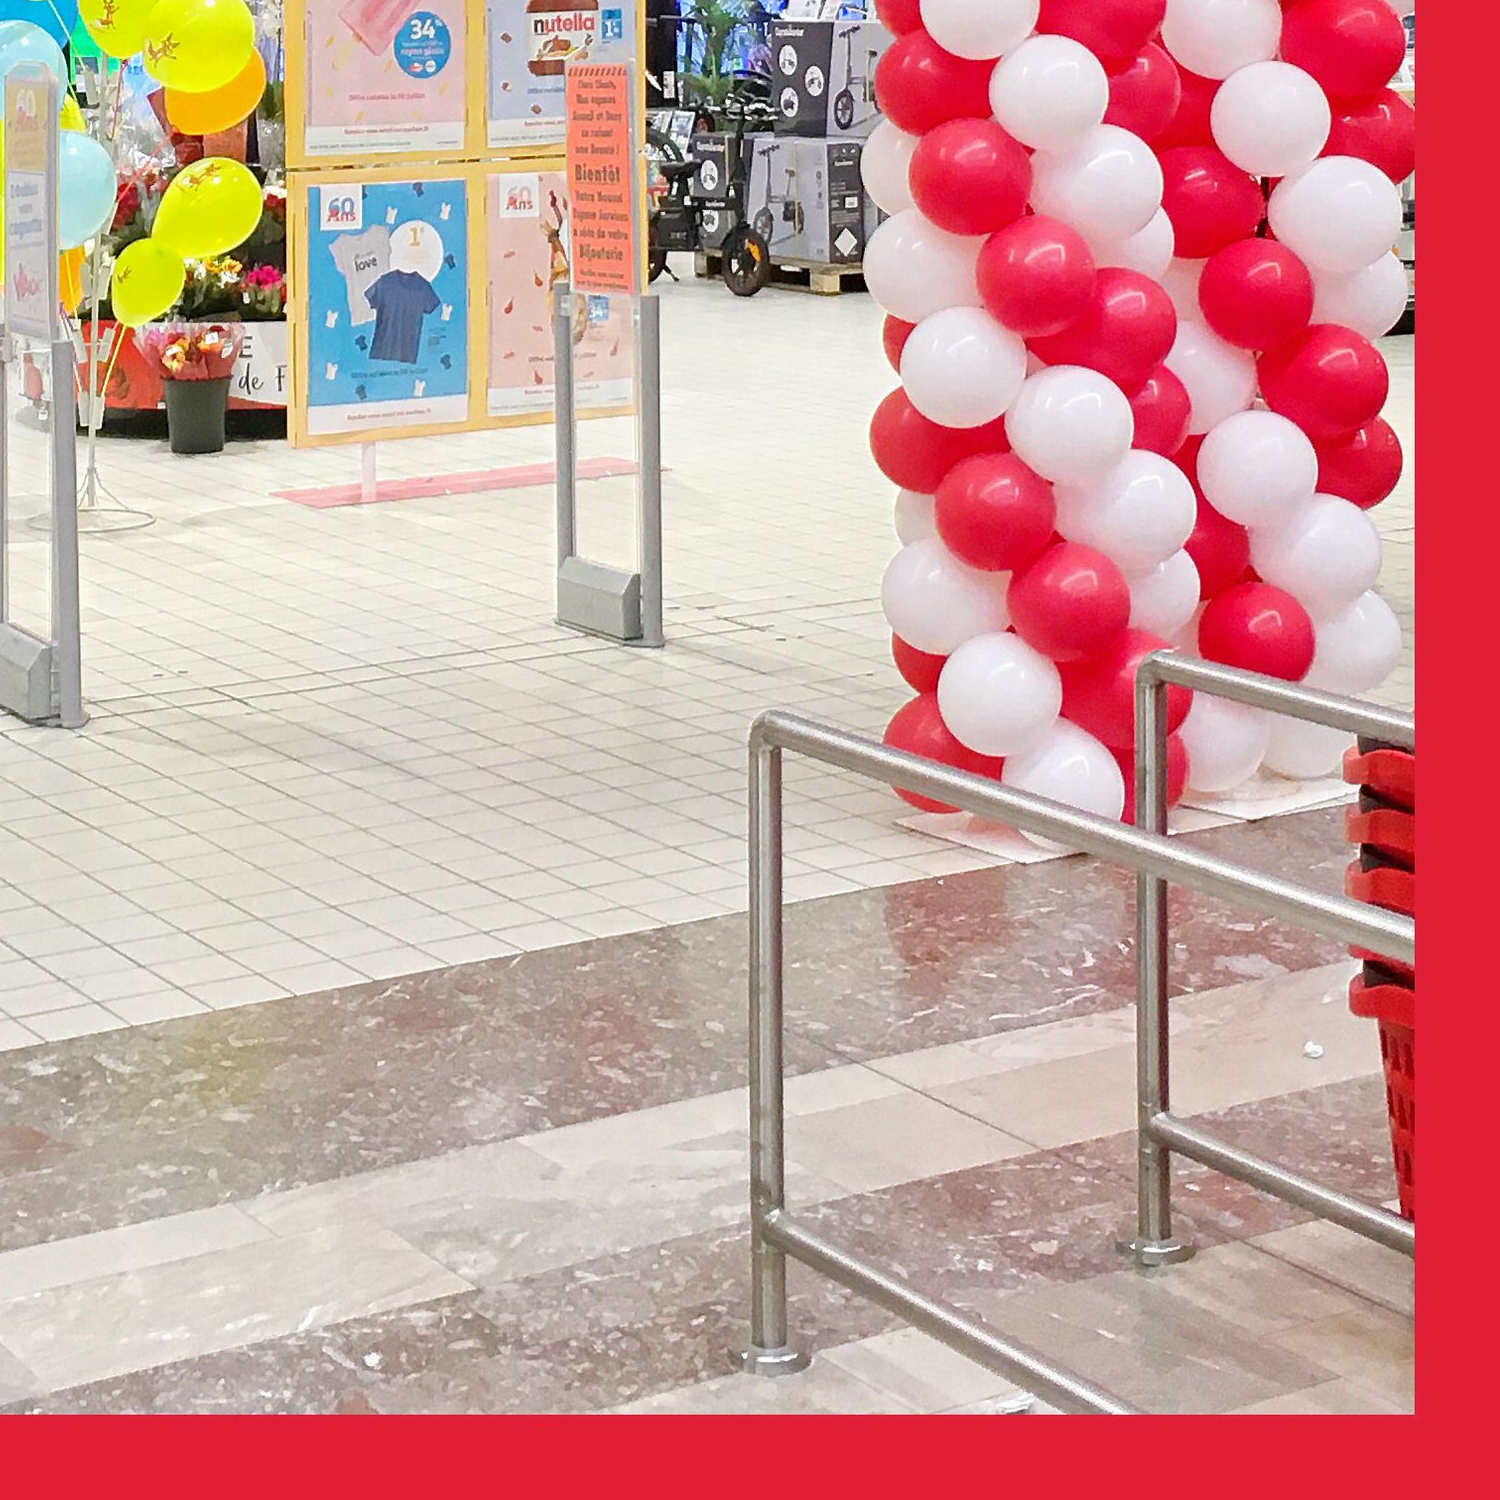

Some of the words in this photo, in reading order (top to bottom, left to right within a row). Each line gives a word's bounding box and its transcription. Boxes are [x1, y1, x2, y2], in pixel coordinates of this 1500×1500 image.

[533, 11, 596, 35] nutella
[575, 164, 620, 182] Bientôt
[327, 207, 357, 222] Ans
[355, 256, 378, 272] love
[239, 363, 264, 396] de
